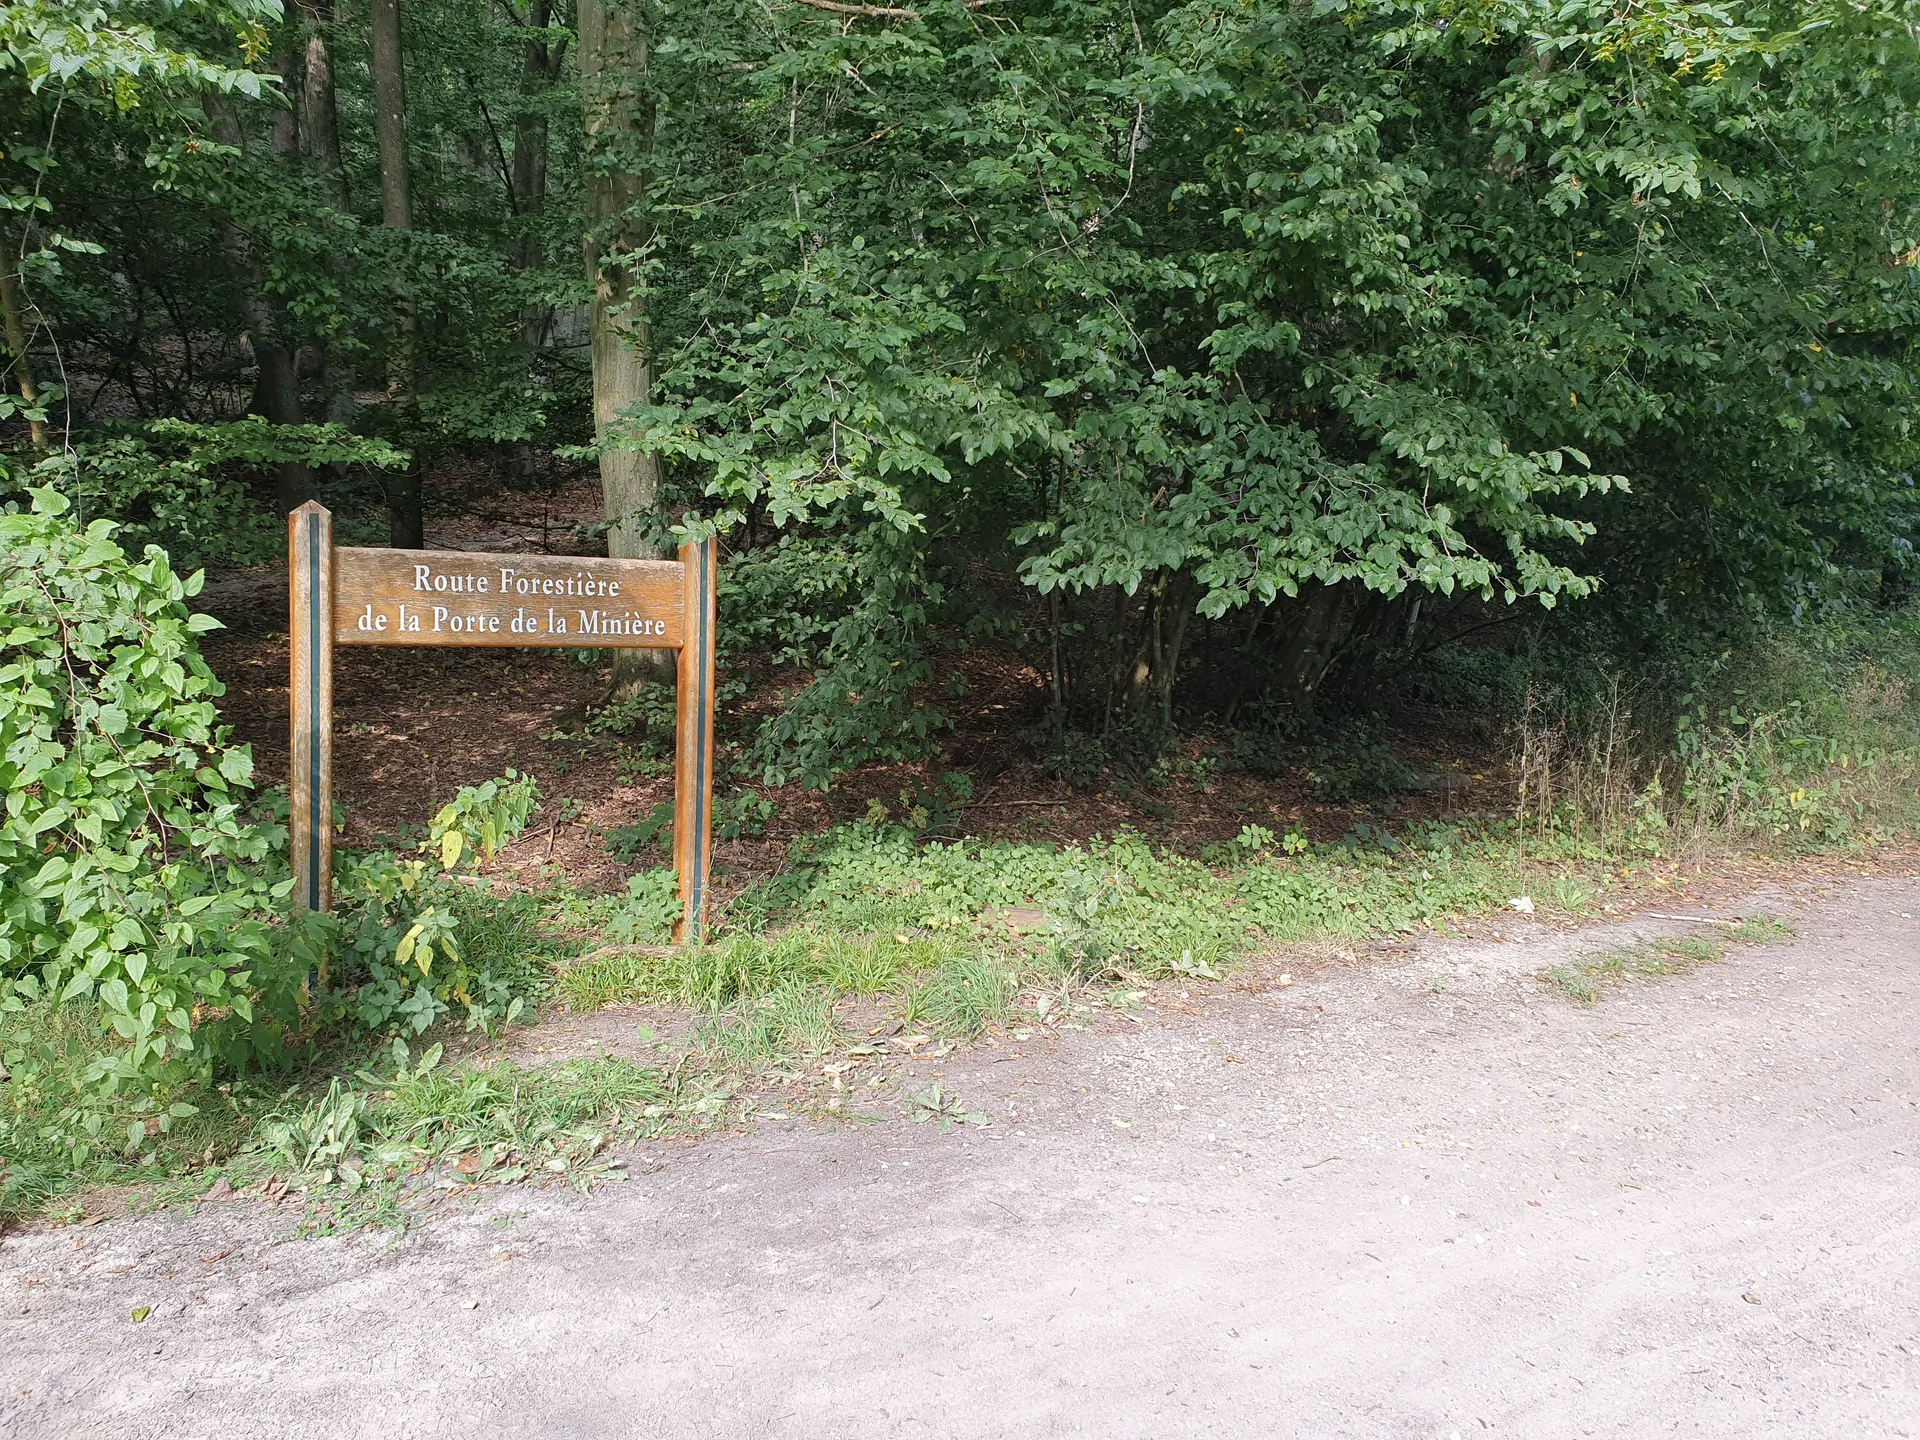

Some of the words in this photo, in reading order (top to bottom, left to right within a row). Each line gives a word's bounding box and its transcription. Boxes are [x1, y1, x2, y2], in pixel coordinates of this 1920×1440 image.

[413, 564, 489, 593] Route
[499, 568, 620, 597] Forestière
[358, 604, 387, 632] de
[399, 604, 421, 632] la
[432, 606, 500, 633] Porte
[510, 608, 538, 634] de
[547, 608, 568, 635] la
[577, 610, 667, 636] Minière
